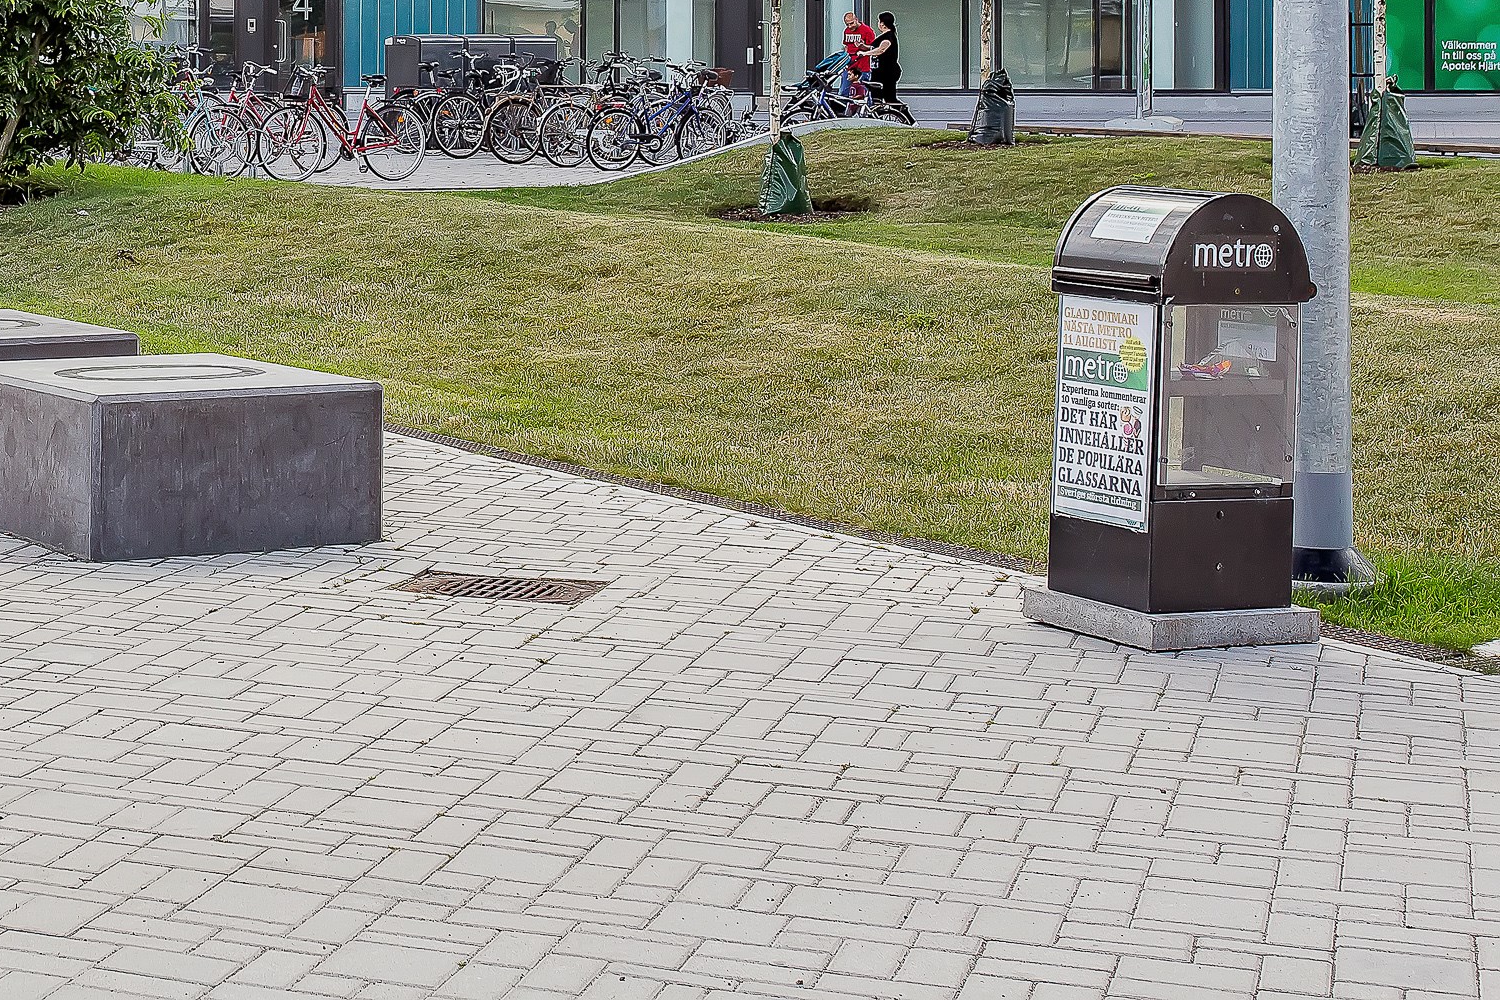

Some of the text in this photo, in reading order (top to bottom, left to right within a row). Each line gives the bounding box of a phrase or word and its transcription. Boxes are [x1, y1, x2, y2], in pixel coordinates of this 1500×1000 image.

[1441, 40, 1497, 50] Välkommen
[1441, 61, 1476, 71] Apotek
[1452, 50, 1464, 60] till
[1484, 50, 1496, 62] på
[1194, 238, 1273, 268] metro
[1064, 307, 1138, 326] GLAD SOMMAR!
[1063, 320, 1132, 338] NÄSTA METRO
[1063, 334, 1117, 351] 11 AUGUSTI
[1064, 354, 1128, 383] metro
[1061, 383, 1146, 404] Experterna kommenterar
[1061, 395, 1120, 411] 10 vanliga sorter:
[1060, 406, 1118, 430] DET HÄR
[1059, 426, 1144, 456] INNEHÅLLER
[1058, 446, 1143, 477] DE POPULÄRA
[1058, 466, 1142, 497] GLASSARNA
[1060, 487, 1086, 500] Sveriges
[1110, 494, 1137, 511] tidning
